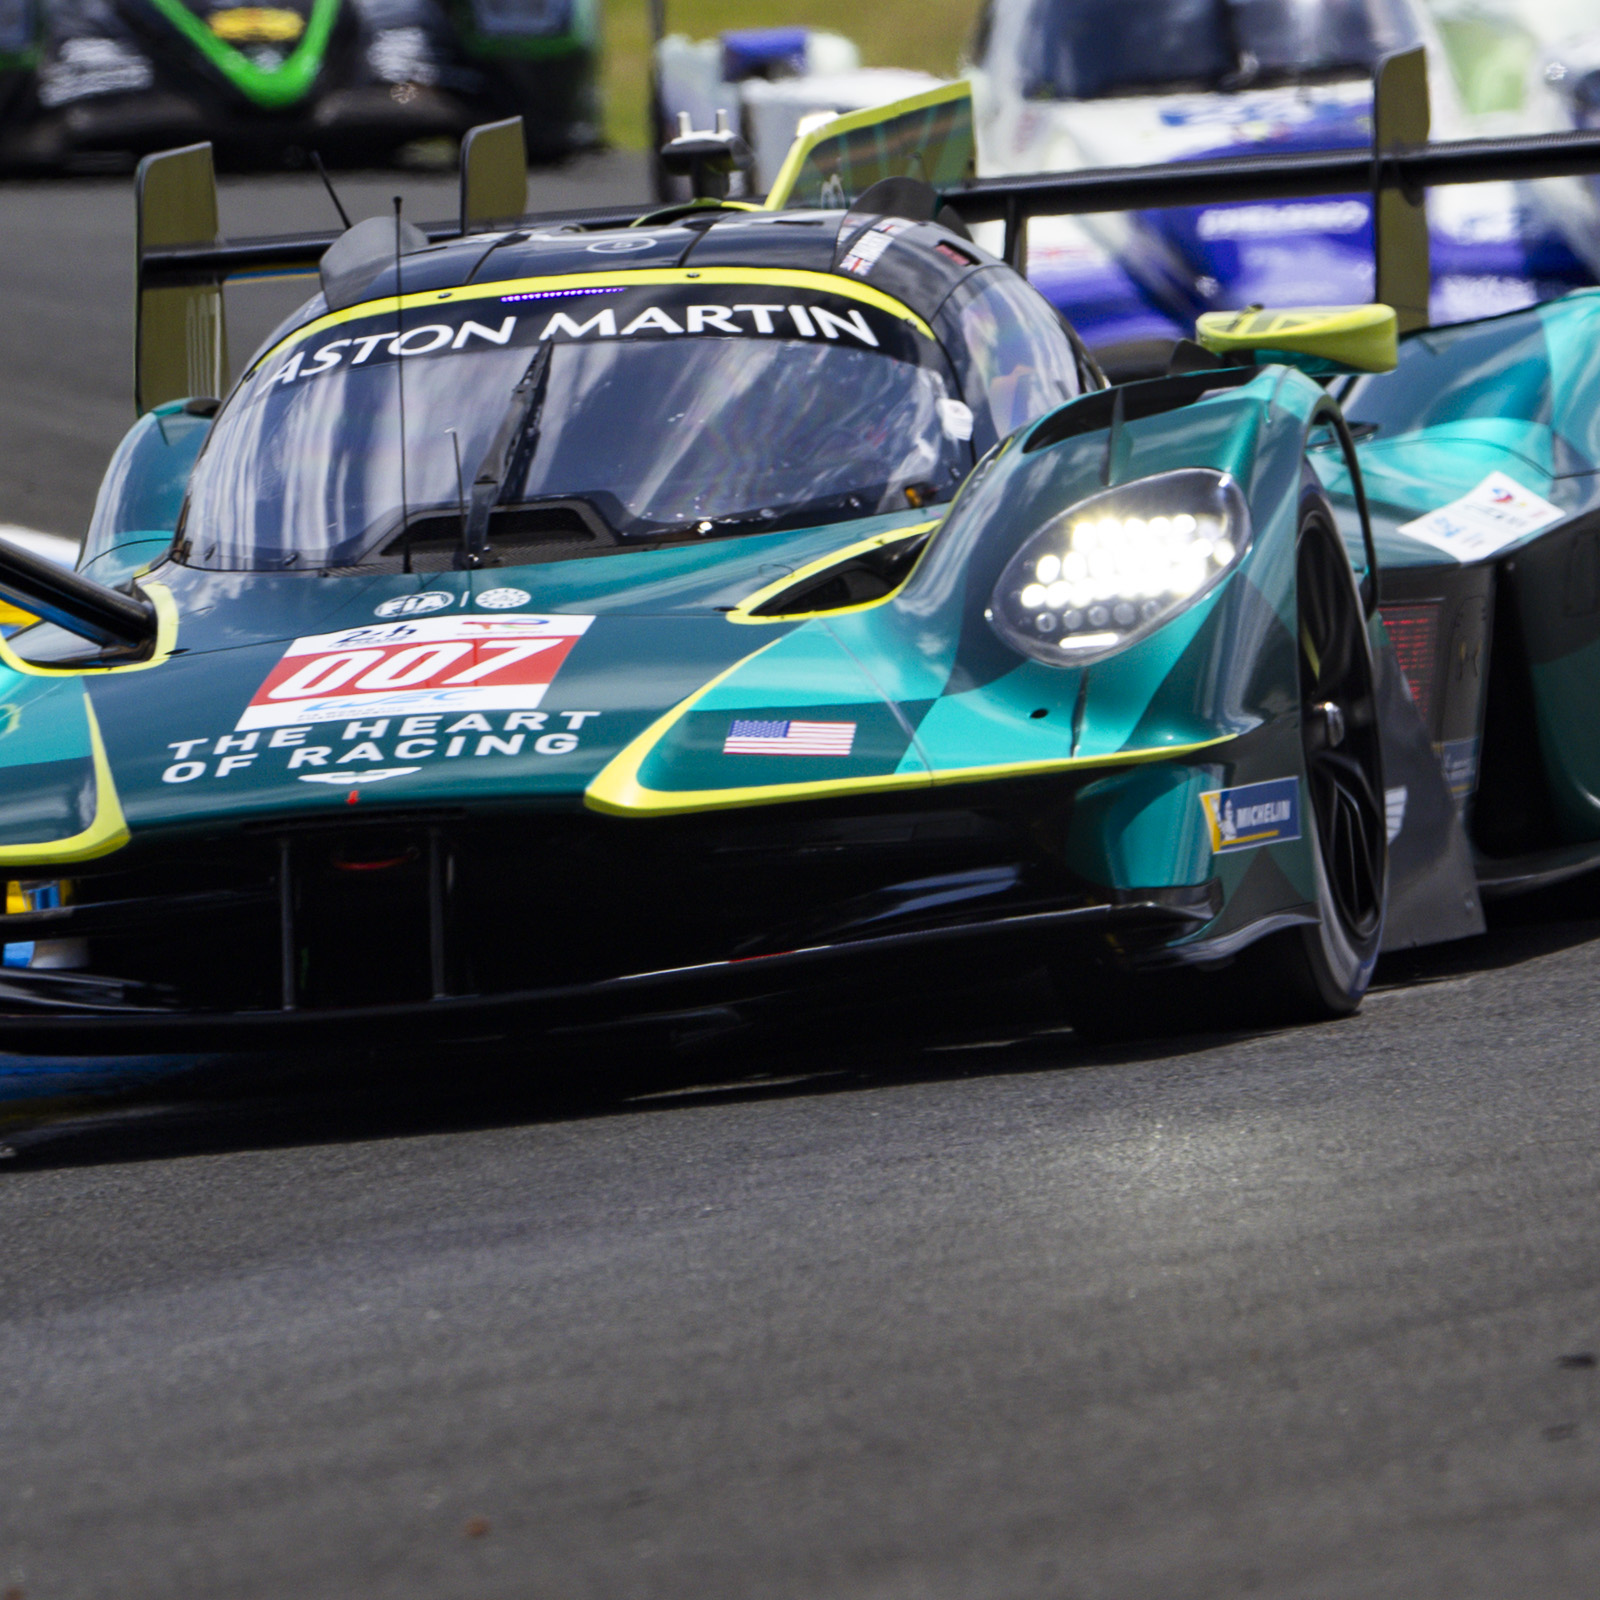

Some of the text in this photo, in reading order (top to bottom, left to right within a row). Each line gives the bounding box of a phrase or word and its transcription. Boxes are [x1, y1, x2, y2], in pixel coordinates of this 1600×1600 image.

[258, 304, 880, 394] ASTON MARTIN
[381, 596, 447, 615] FIA
[268, 638, 565, 699] 007
[303, 689, 485, 712] WEC
[161, 733, 580, 784] OF RACING
[167, 711, 601, 760] THE HEART
[1236, 800, 1290, 829] MICHELIN
